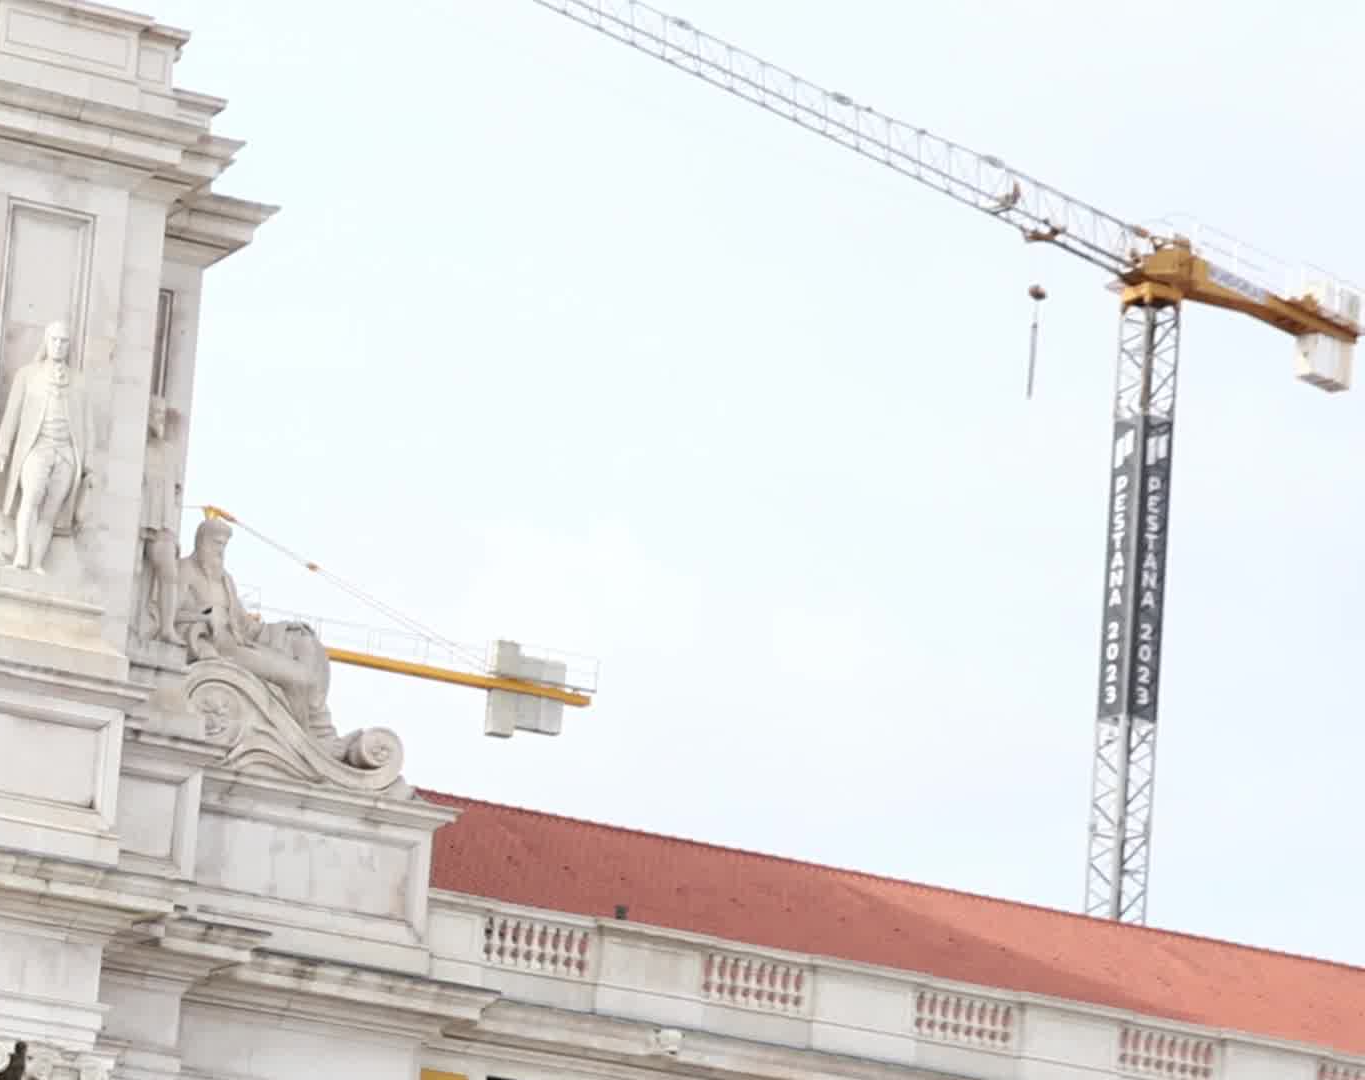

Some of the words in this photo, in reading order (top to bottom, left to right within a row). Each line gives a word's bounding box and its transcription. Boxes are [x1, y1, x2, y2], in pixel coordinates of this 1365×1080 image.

[1108, 475, 1129, 607] PESTANA
[1140, 475, 1162, 608] PESTANA
[1104, 621, 1119, 705] 2023
[1135, 622, 1153, 706] 2023
